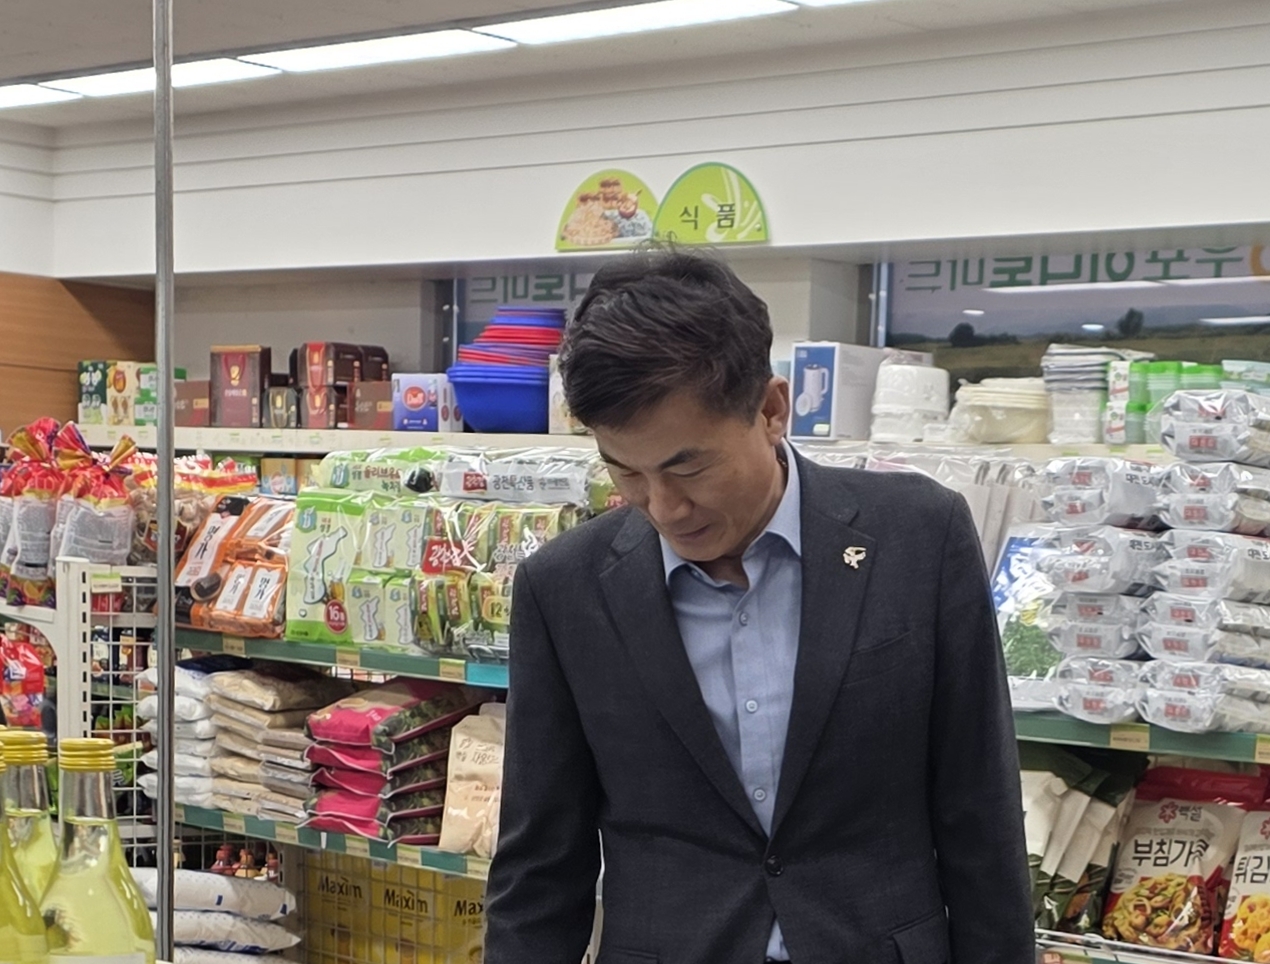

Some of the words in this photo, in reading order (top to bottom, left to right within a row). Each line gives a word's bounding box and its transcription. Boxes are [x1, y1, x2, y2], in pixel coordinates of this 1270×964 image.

[680, 203, 736, 230] 식품
[1178, 805, 1202, 822] 백설
[318, 875, 363, 899] Maxim
[384, 888, 429, 914] Maxim
[454, 895, 484, 917] Max
